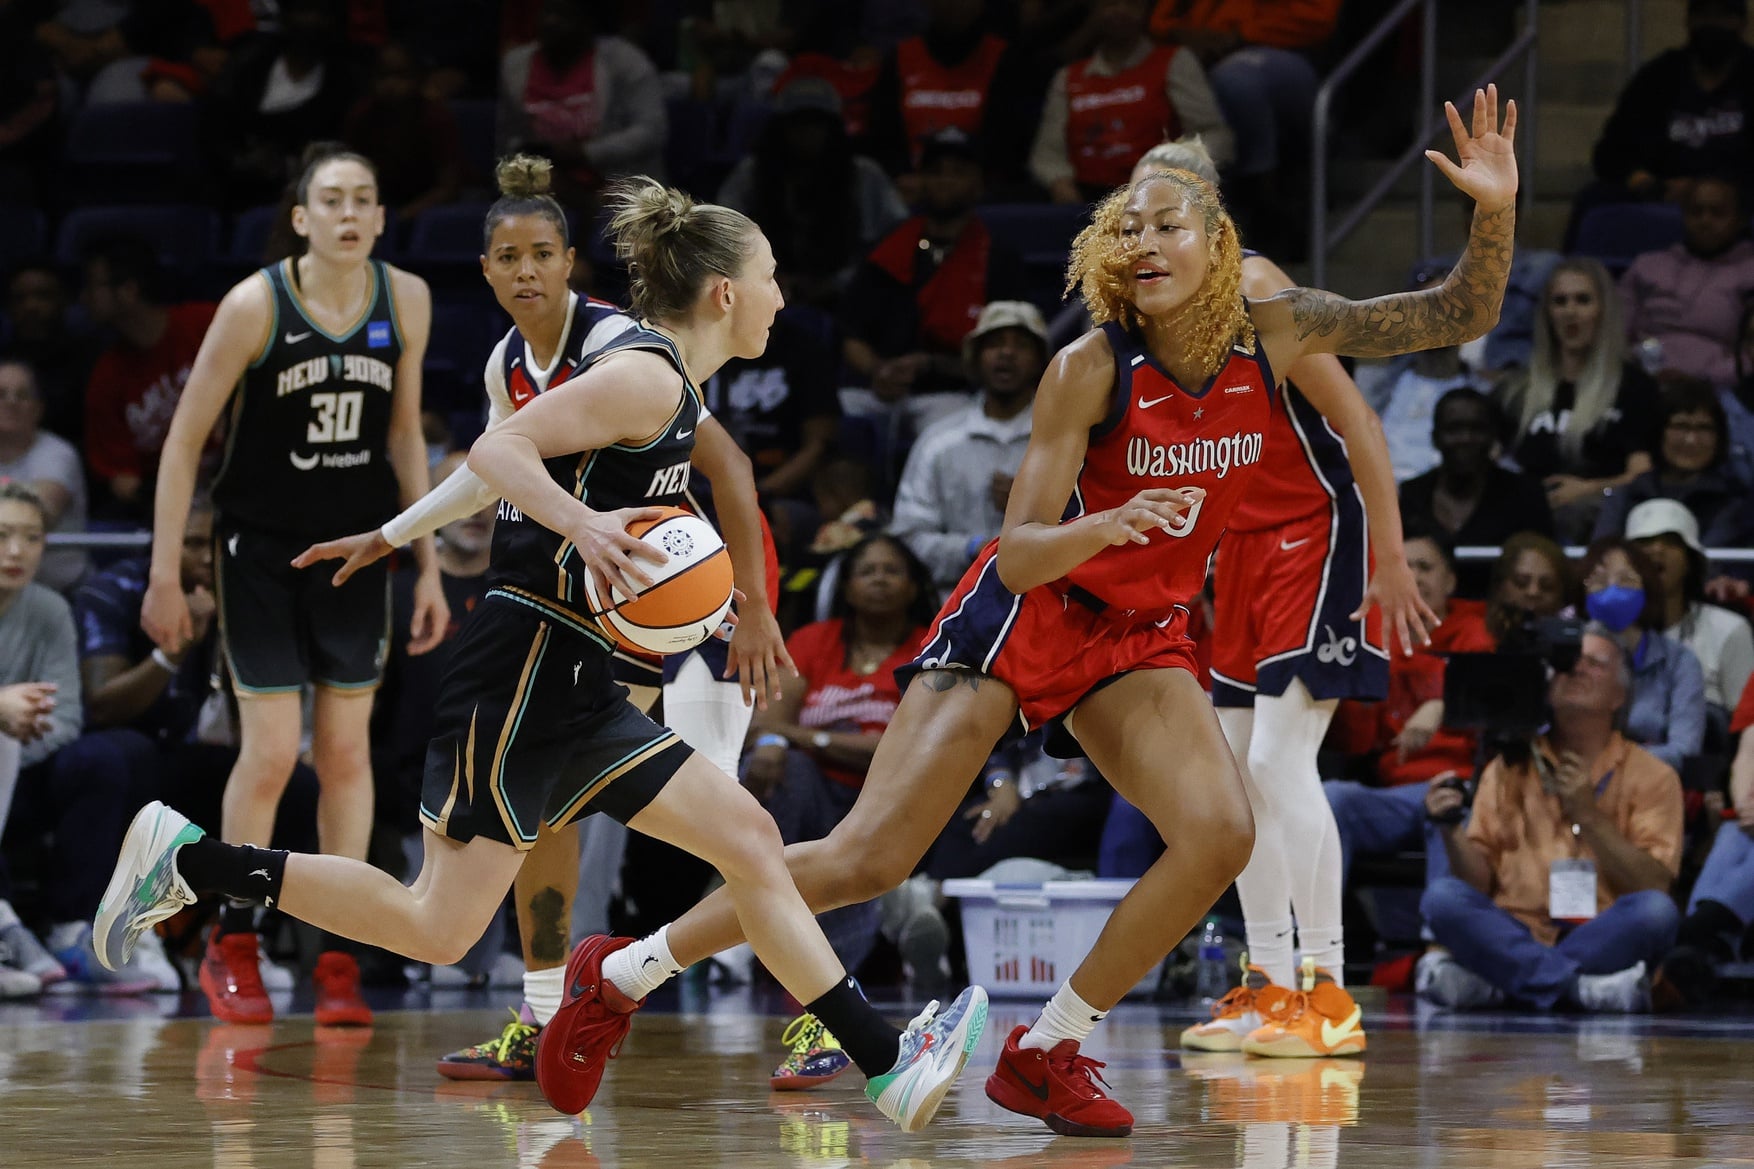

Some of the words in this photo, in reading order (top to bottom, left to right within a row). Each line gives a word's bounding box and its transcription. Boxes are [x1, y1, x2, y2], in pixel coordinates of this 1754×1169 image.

[277, 355, 329, 398] NEW
[343, 354, 393, 392] YORK
[307, 391, 364, 443] 30
[1126, 430, 1263, 479] Washington
